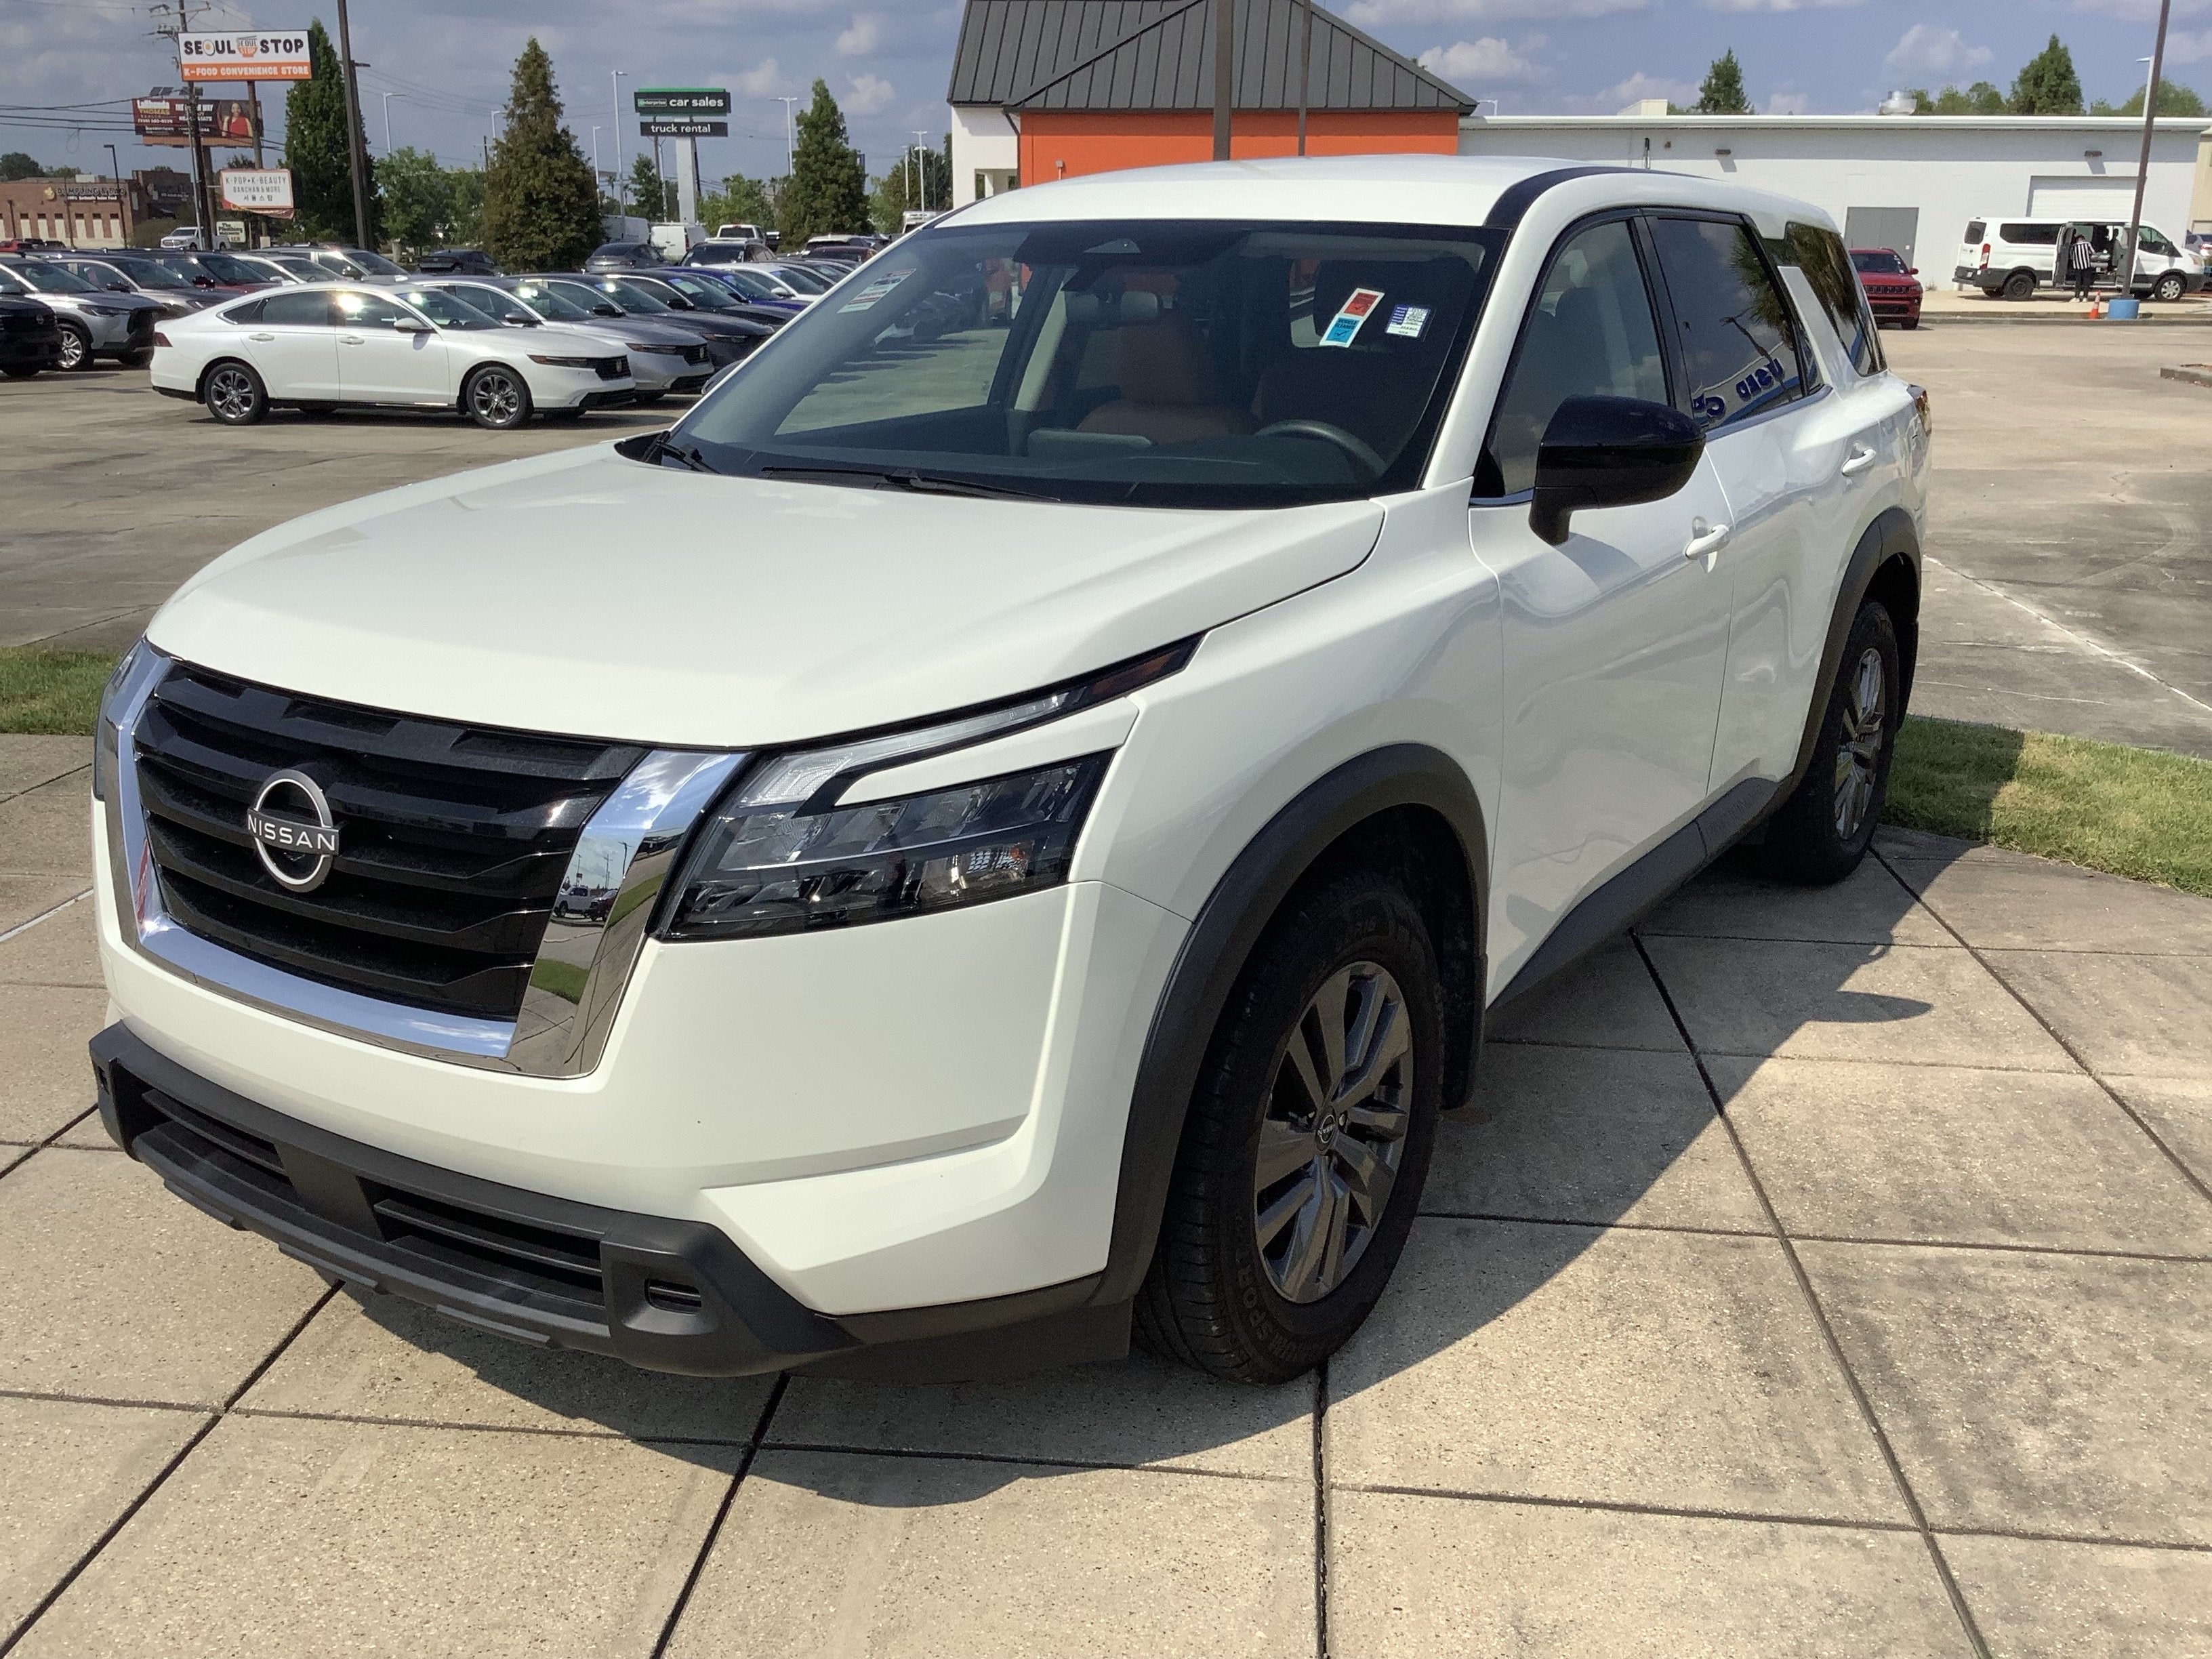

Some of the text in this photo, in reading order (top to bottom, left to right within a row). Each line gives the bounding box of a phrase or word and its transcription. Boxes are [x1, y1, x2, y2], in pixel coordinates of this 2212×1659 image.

[184, 38, 304, 56] SEOUL STOP
[184, 66, 308, 76] K-FOOD CONVENIENCE STORE
[669, 98, 689, 107] car
[691, 96, 724, 107] sales
[651, 123, 711, 133] truck rental
[248, 815, 335, 851] NISSAN
